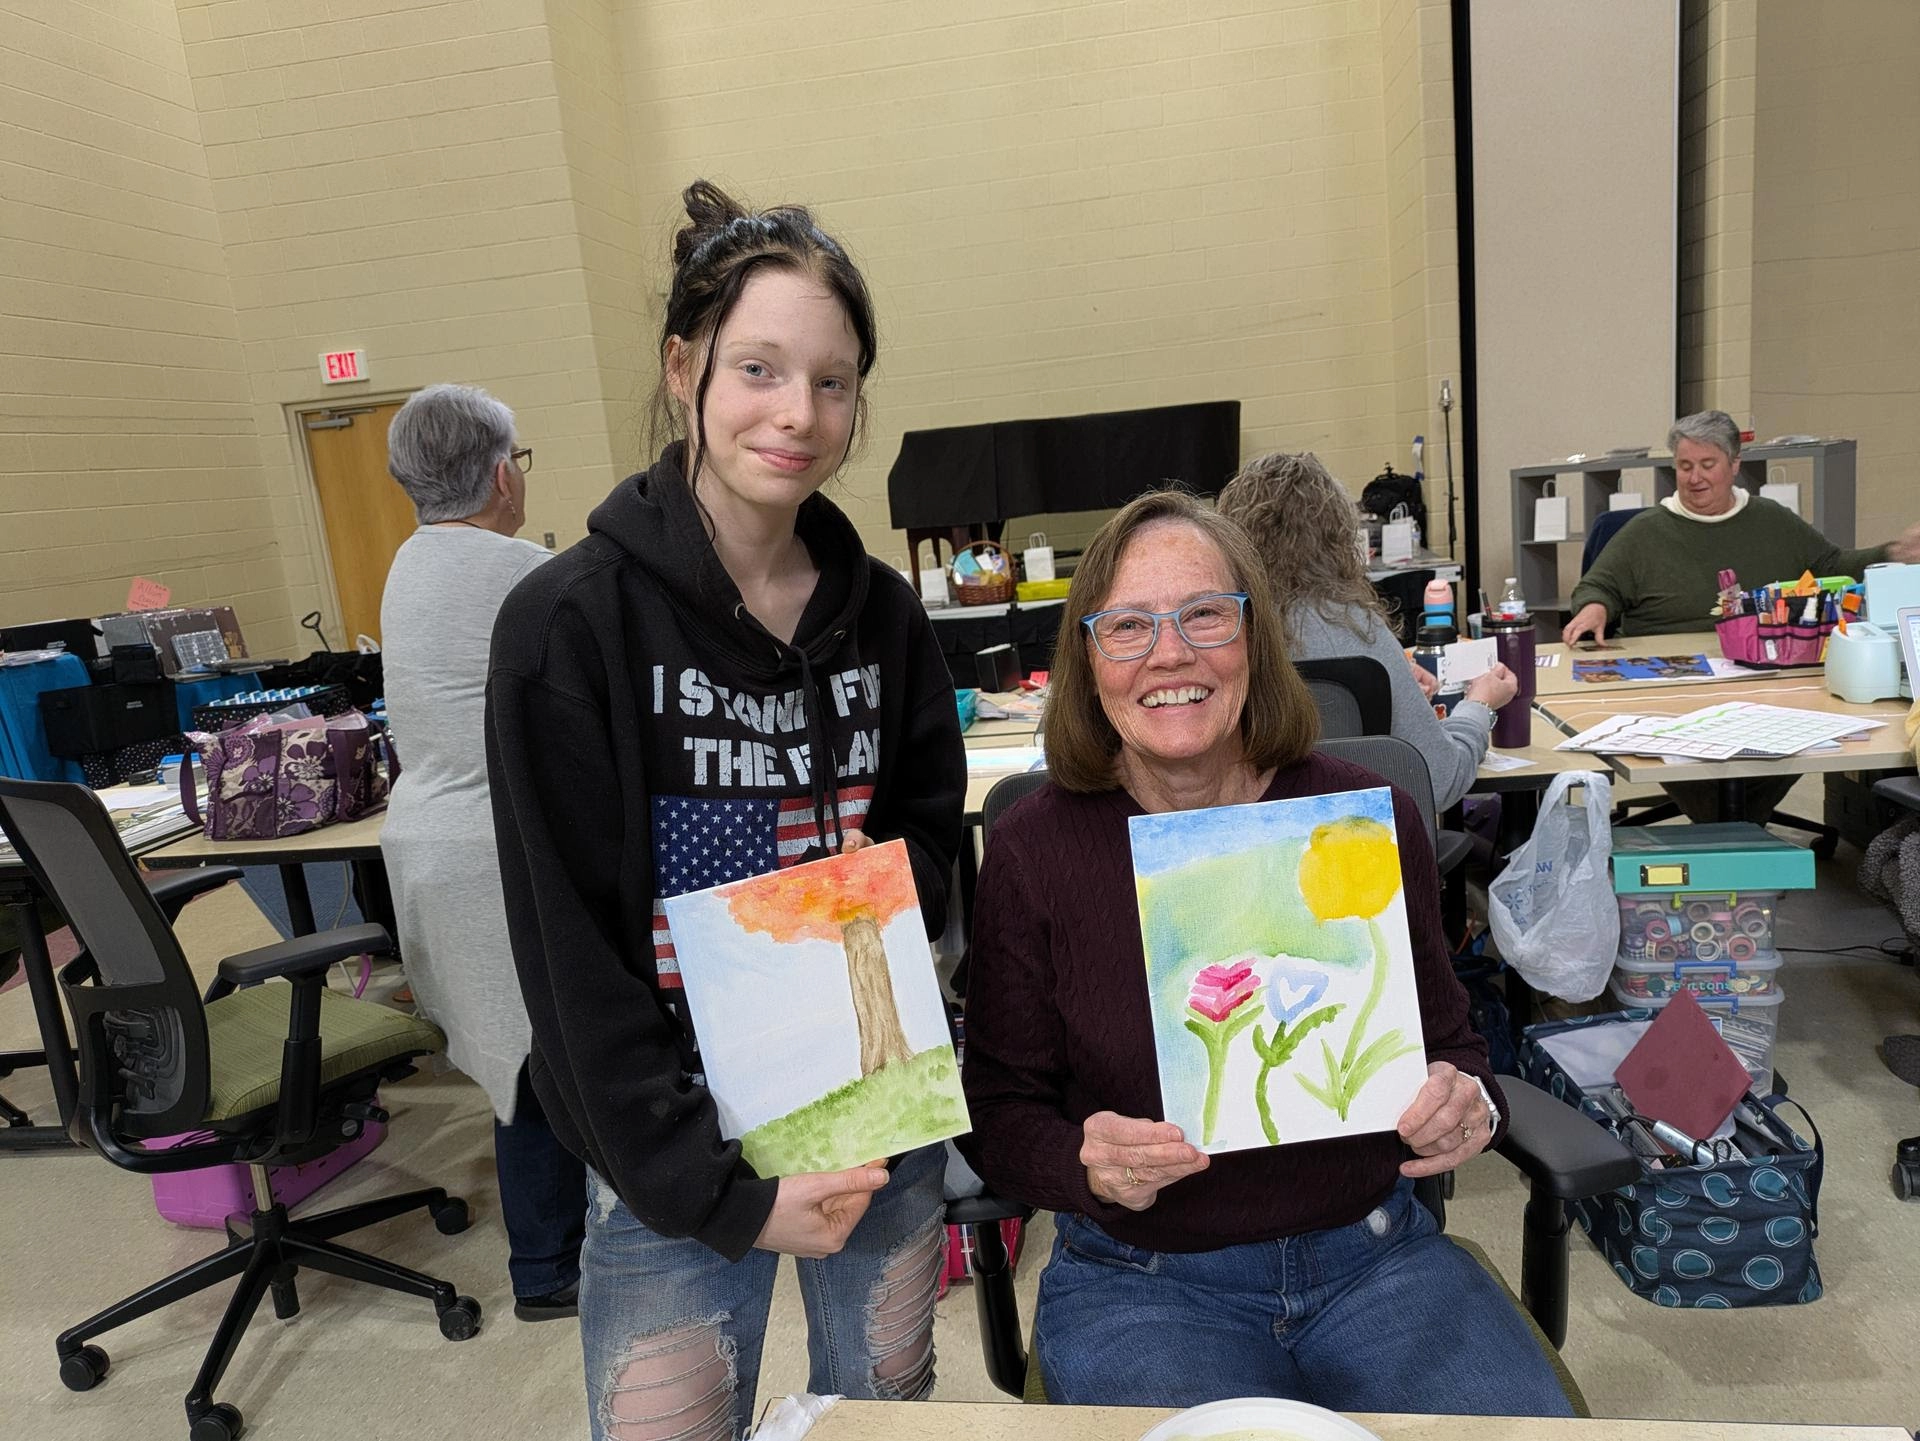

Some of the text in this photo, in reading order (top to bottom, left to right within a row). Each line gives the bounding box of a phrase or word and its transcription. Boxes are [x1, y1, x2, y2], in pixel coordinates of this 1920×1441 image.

[326, 353, 357, 378] EXIT
[653, 665, 664, 714] I
[683, 737, 786, 786] THE
